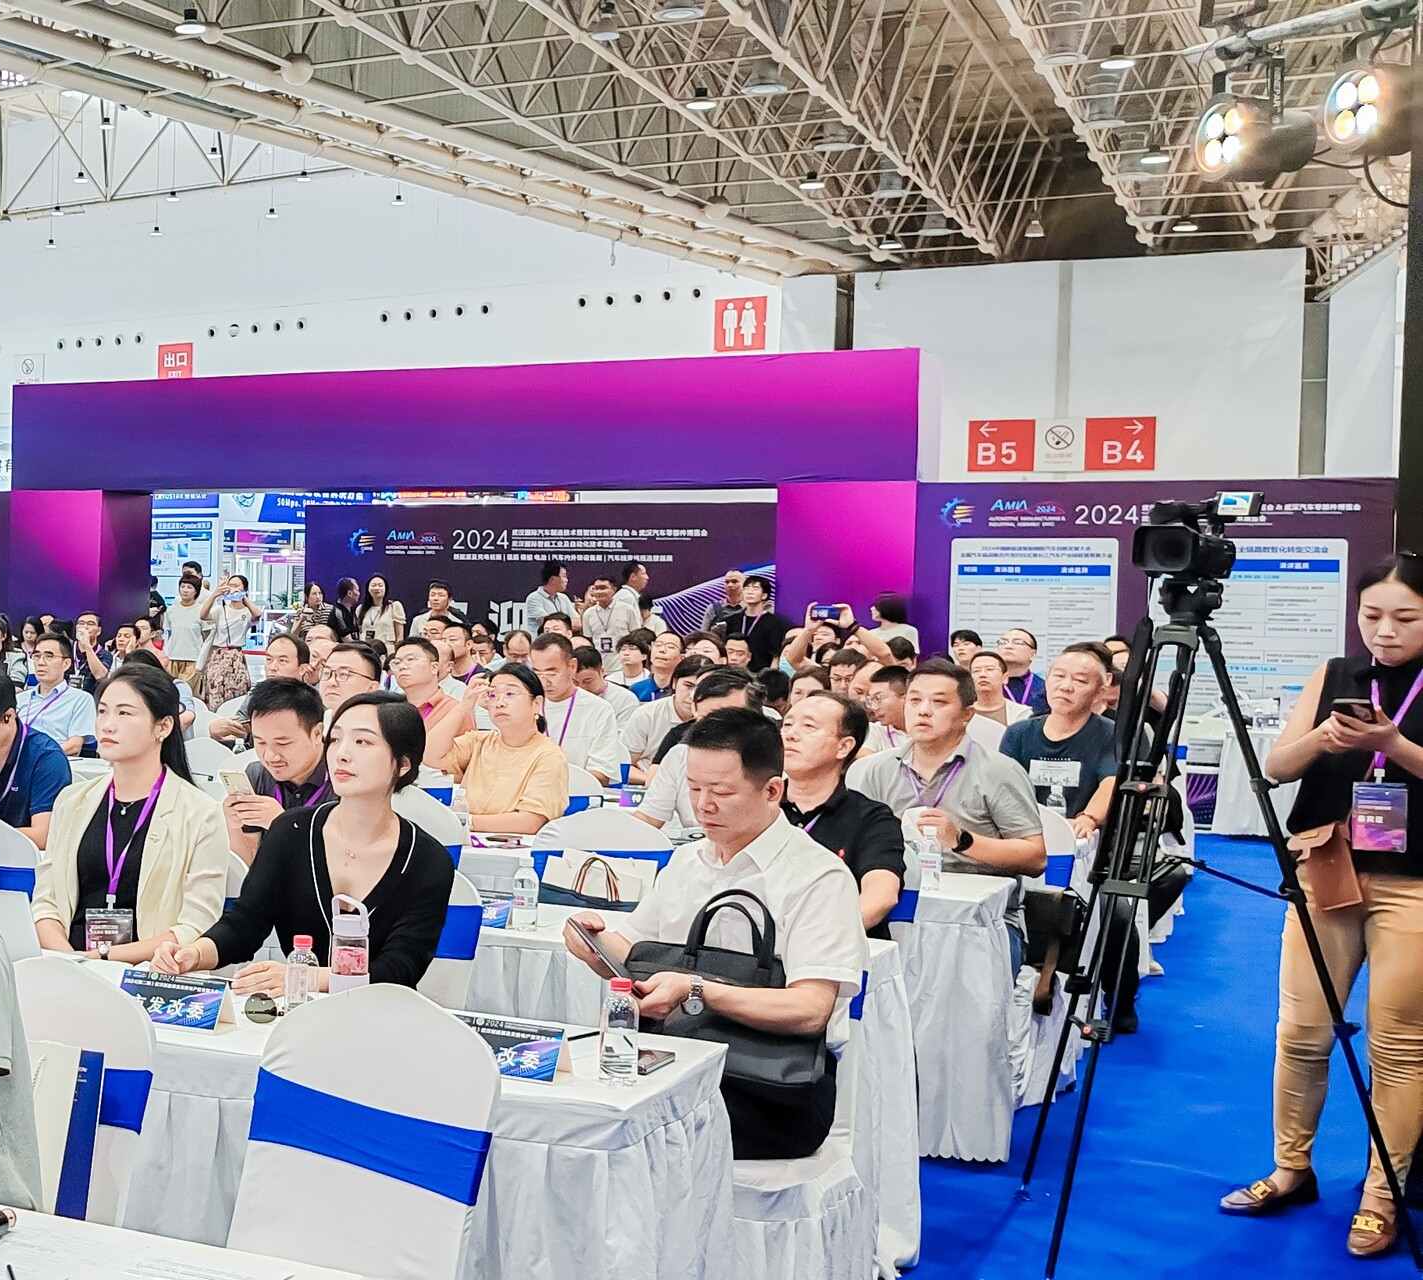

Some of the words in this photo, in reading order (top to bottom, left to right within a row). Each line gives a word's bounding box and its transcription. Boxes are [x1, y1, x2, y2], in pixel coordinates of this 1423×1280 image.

[163, 352, 188, 368] 出口
[977, 441, 1017, 465] B5
[1102, 439, 1145, 464] B4
[1074, 504, 1139, 525] 2024
[452, 529, 510, 550] 2024
[485, 1019, 504, 1028] 2024
